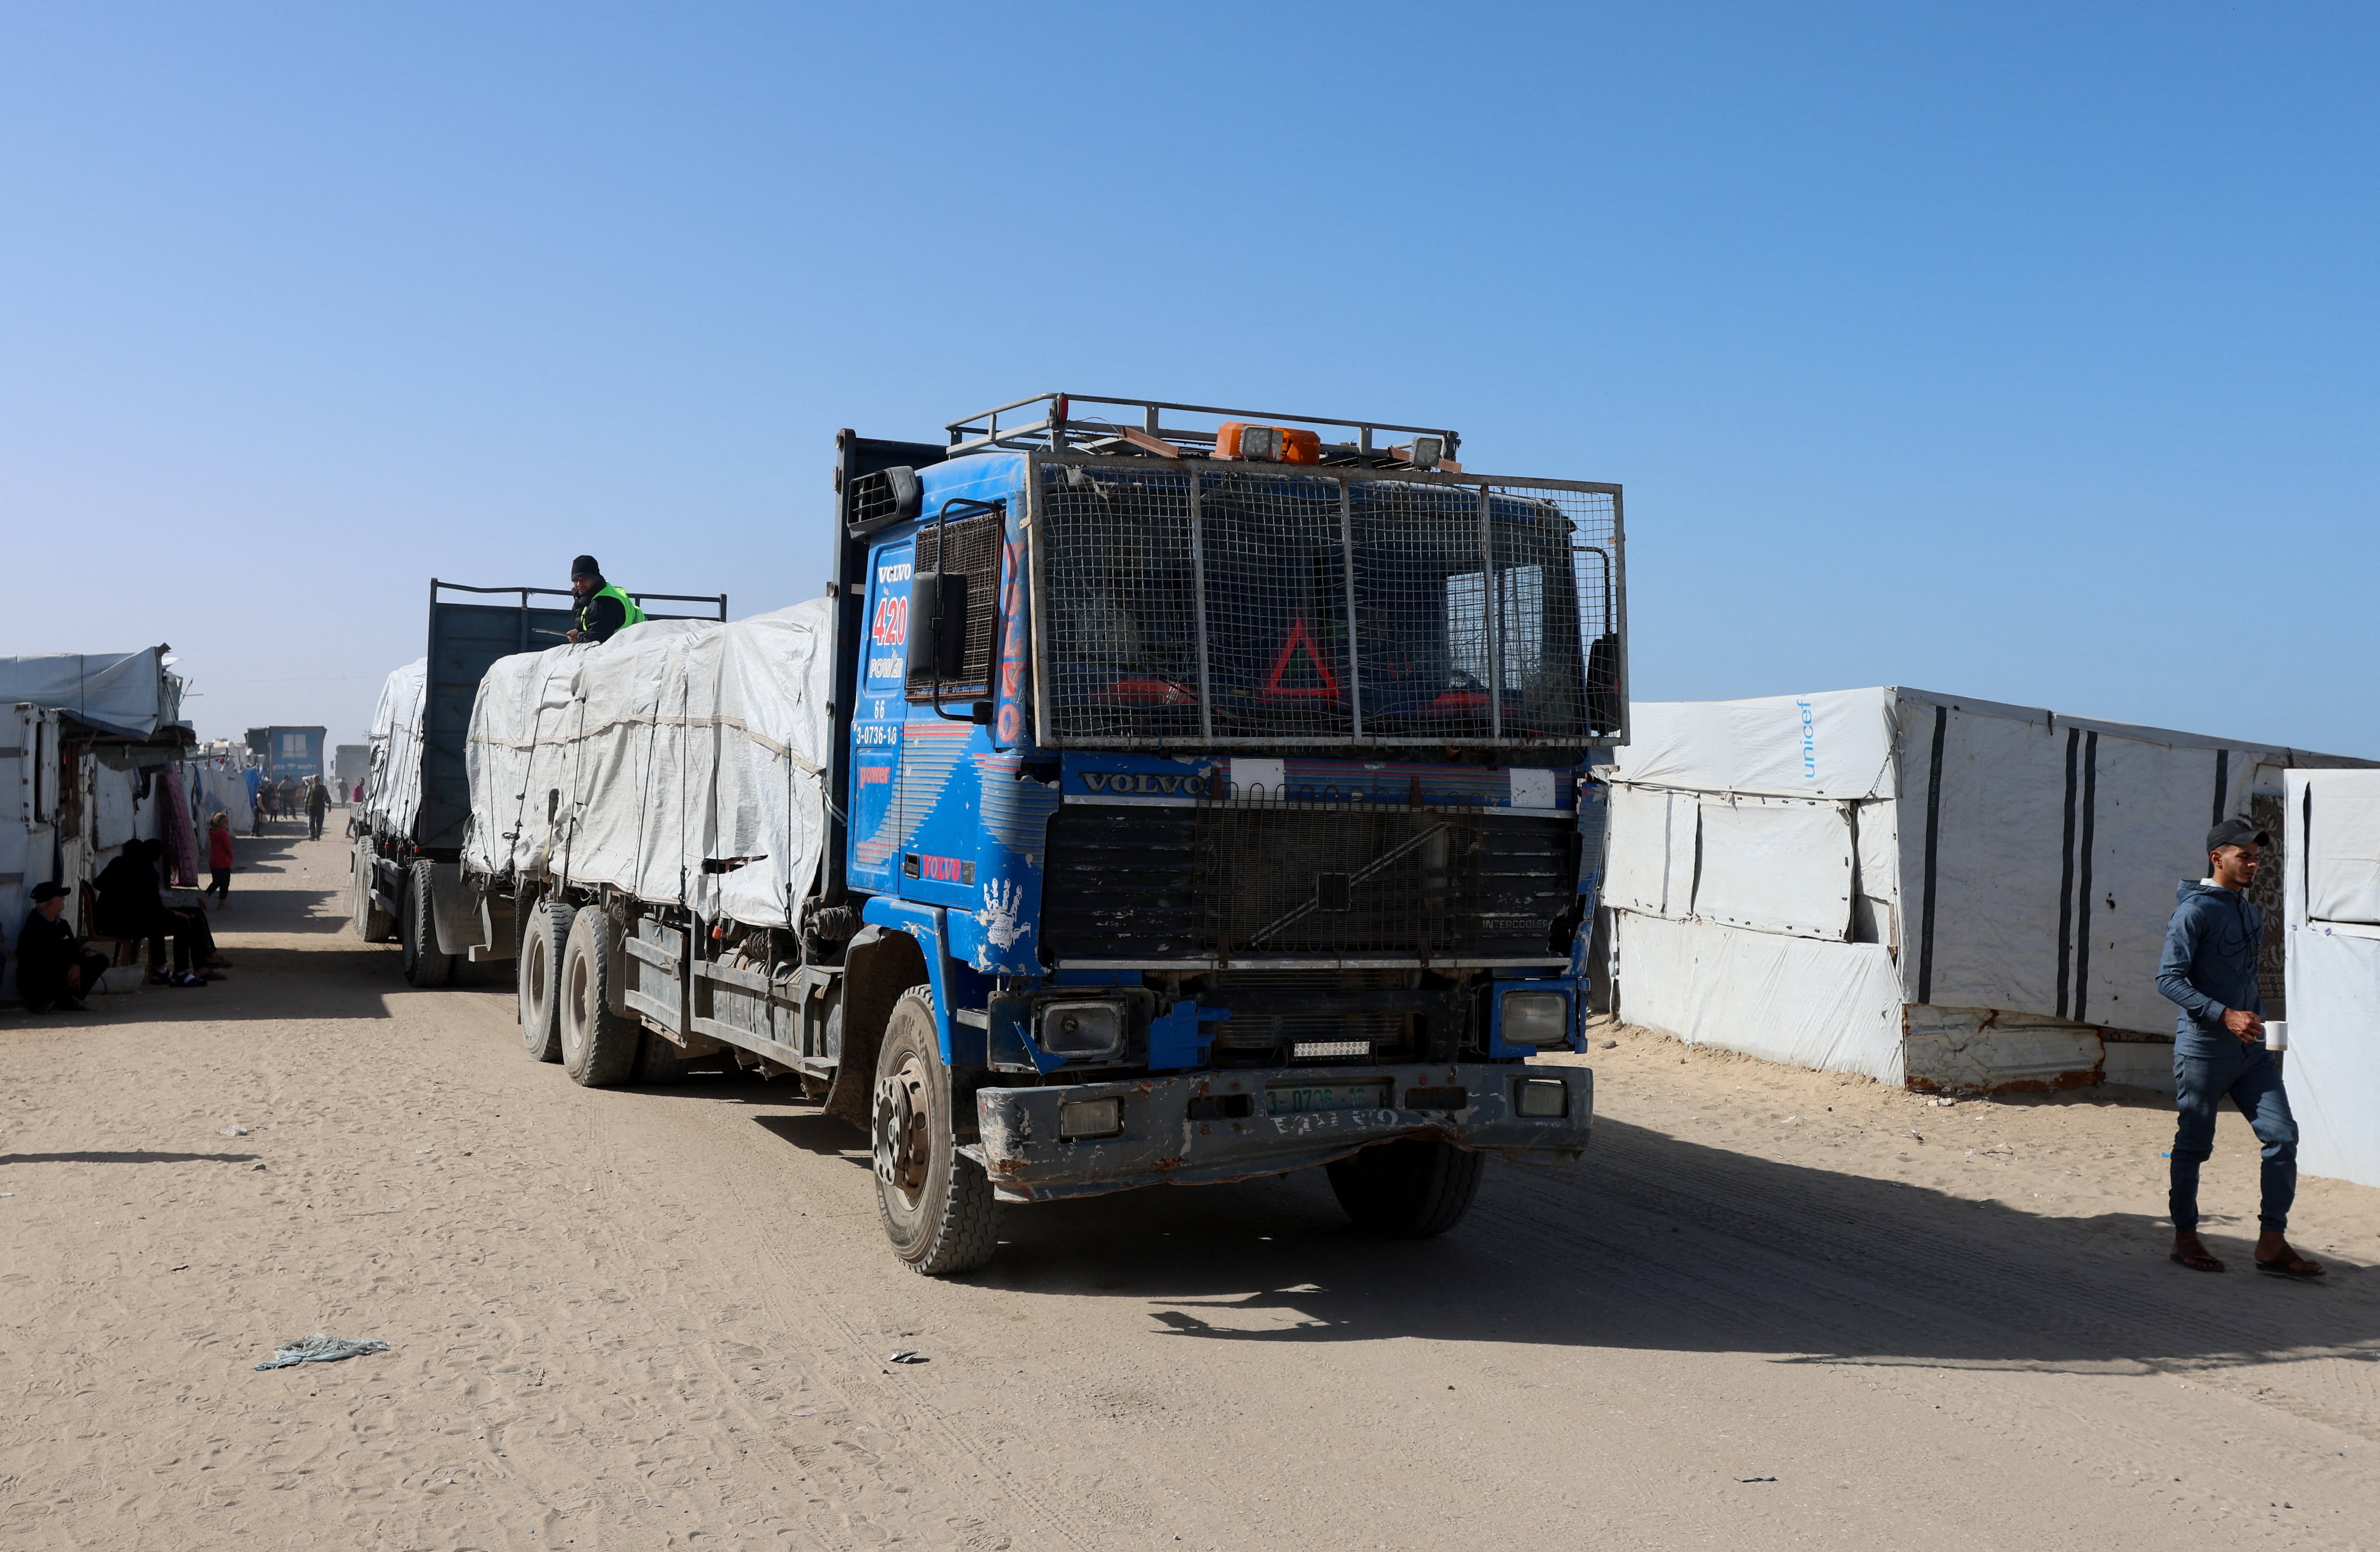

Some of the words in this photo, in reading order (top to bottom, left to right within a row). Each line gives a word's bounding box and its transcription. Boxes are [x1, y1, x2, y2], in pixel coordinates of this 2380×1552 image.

[878, 563, 912, 584] VOLVO
[873, 596, 908, 646] 420
[998, 542, 1027, 743] VOLVO
[869, 658, 903, 678] POWER
[874, 699, 885, 719] 66
[1796, 699, 1815, 778] unicef
[860, 766, 891, 789] power
[1078, 772, 1206, 796] VOLVO
[922, 855, 961, 882] VOLVO
[1482, 919, 1548, 929] INTERCOOLER
